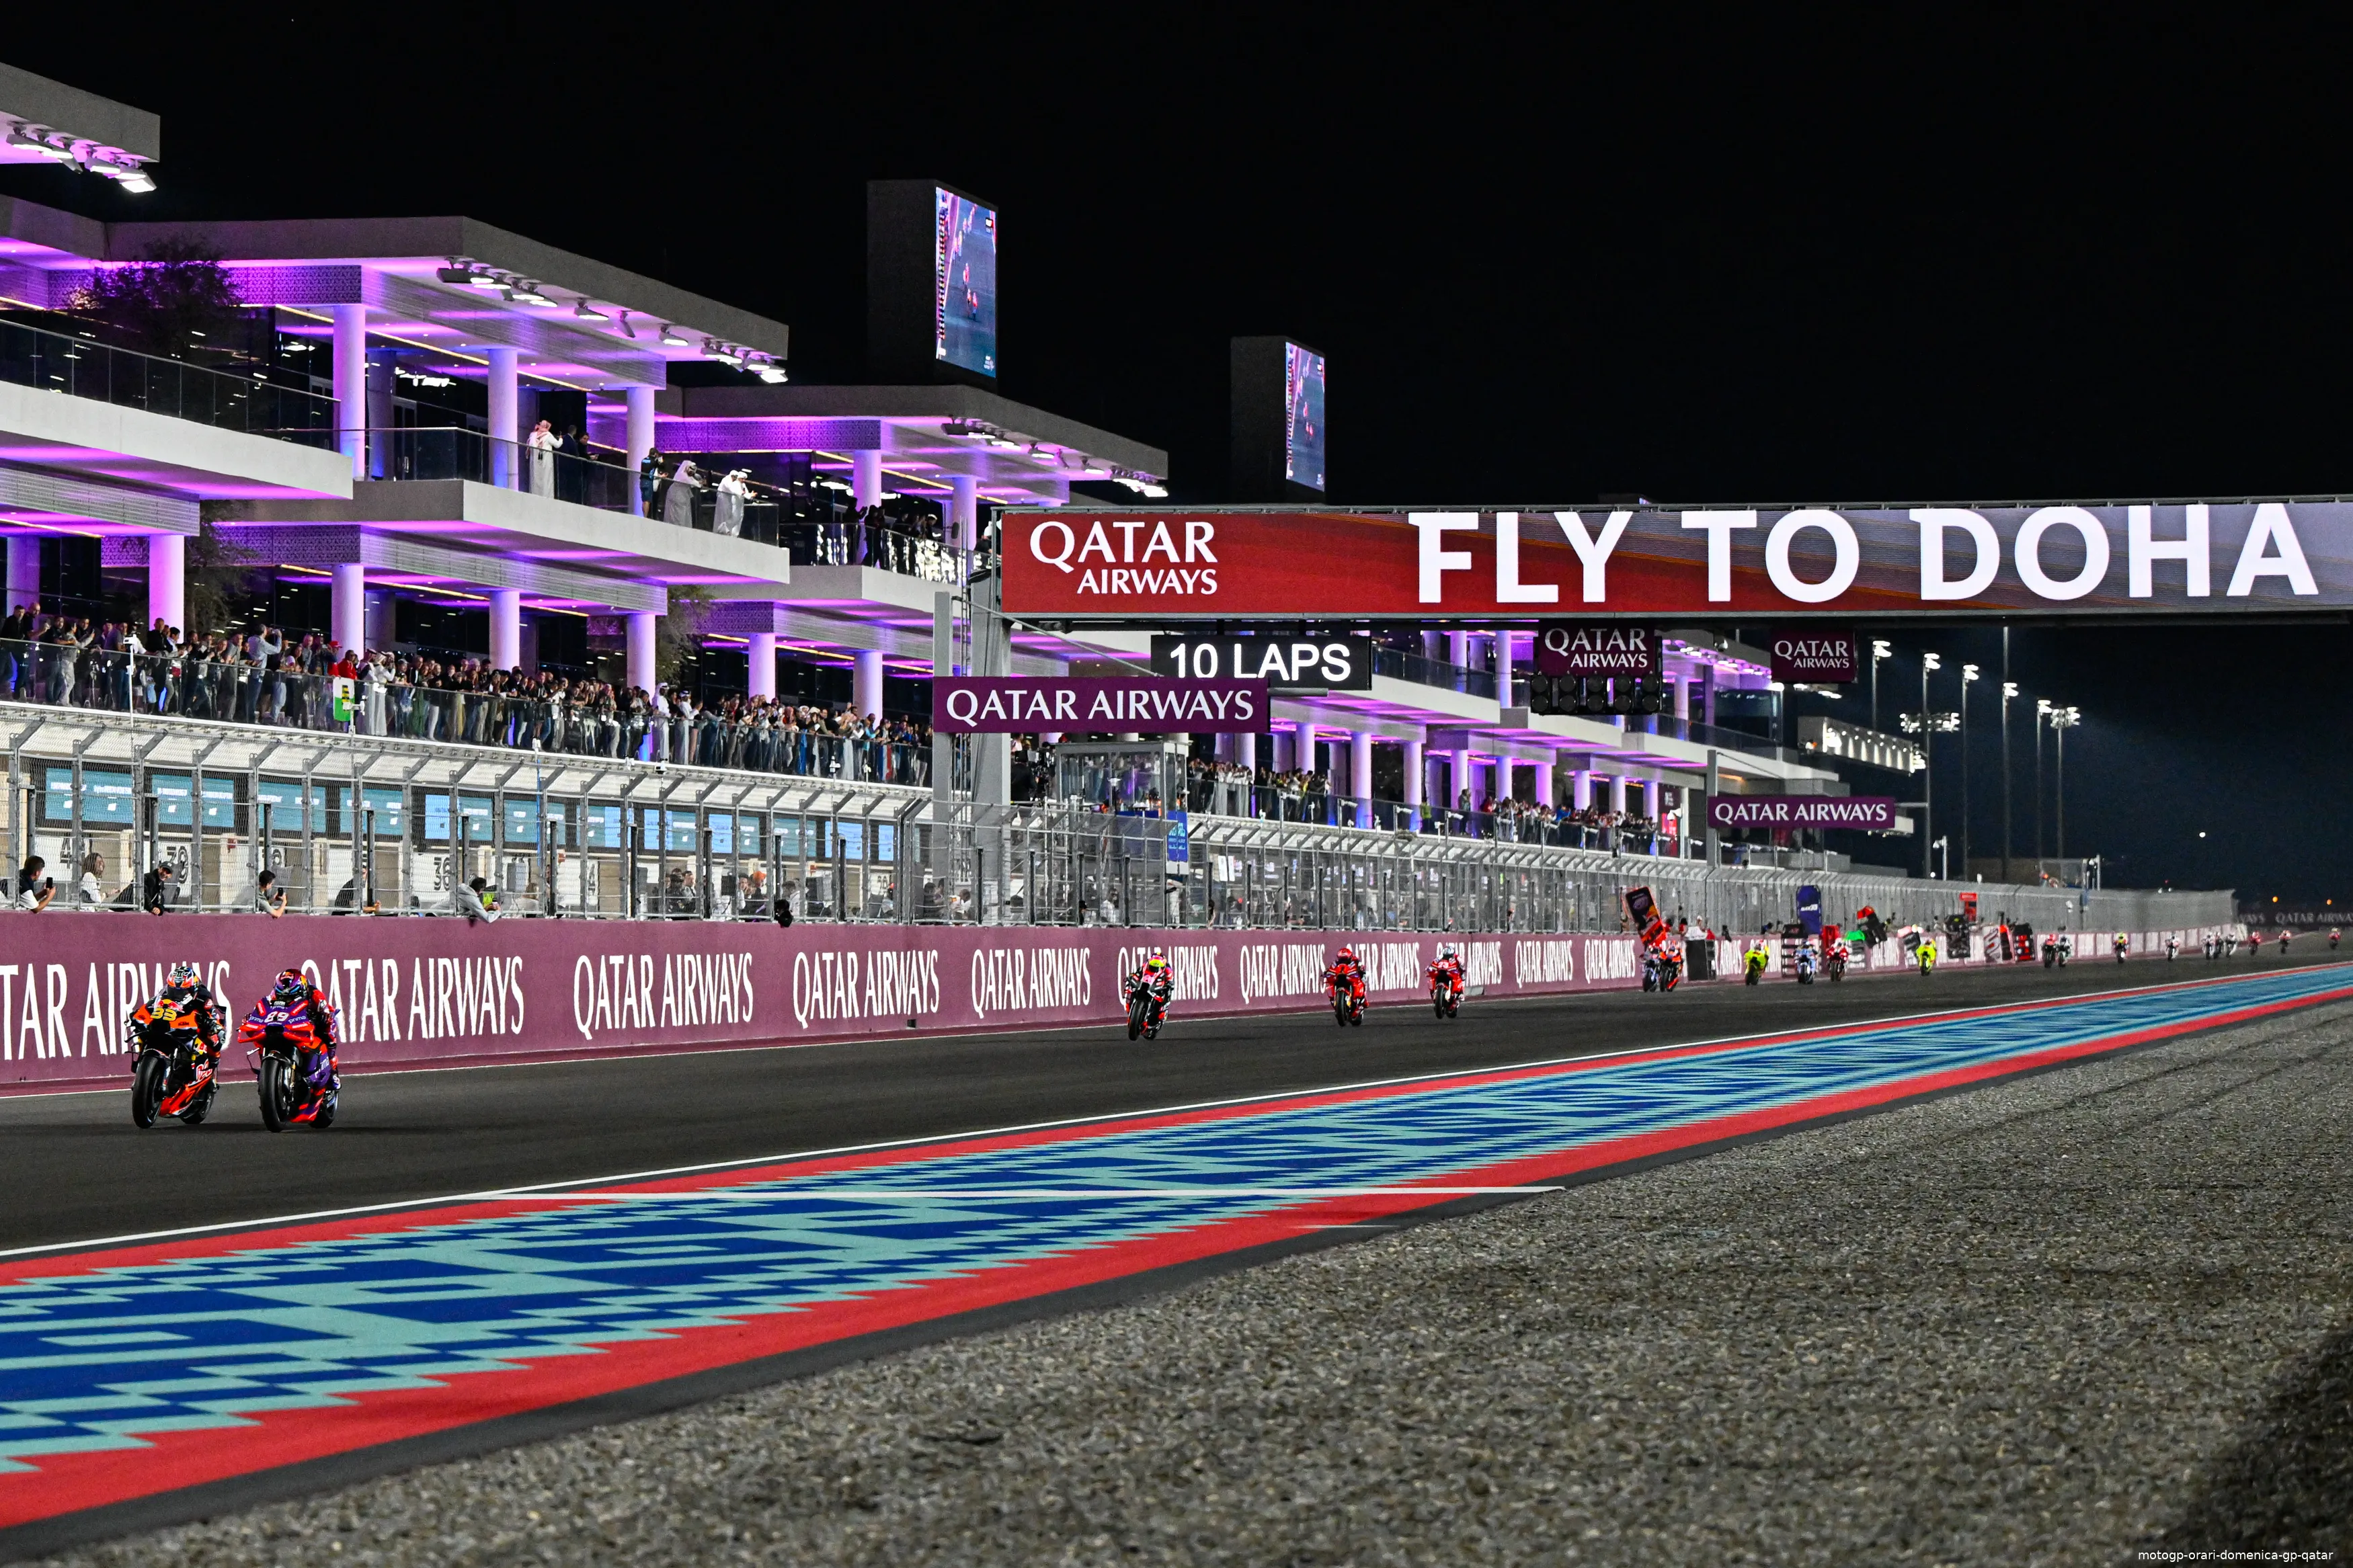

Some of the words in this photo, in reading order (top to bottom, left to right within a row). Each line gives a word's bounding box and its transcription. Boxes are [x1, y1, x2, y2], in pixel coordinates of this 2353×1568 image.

[1030, 521, 1218, 573] QATAR
[1408, 511, 1634, 603] FLY
[1681, 509, 1860, 603] TO
[1909, 503, 2319, 600] DOHA
[1077, 569, 1218, 595] AIRWAYS
[1170, 643, 1218, 678] 10
[1234, 643, 1351, 682] LAPS
[1545, 628, 1647, 657] QATAR
[1570, 653, 1648, 667] AIRWAYS
[1774, 640, 1849, 661] QATAR
[1793, 658, 1849, 669] AIRWAYS
[947, 690, 1078, 727] QATAR
[1088, 690, 1253, 720] AIRWAYS
[1715, 803, 1789, 825] QATAR
[1794, 804, 1887, 821] AIRWAYS
[2275, 911, 2314, 925] QATAR
[2317, 912, 2353, 923] AIRWA
[971, 948, 1027, 1019] QATAR
[1029, 947, 1090, 1009] AIRWAYS
[1168, 945, 1218, 1001] AIRWAYS
[1240, 945, 1279, 1005] QATAR
[1280, 944, 1326, 996] AIRWAYS
[1347, 943, 1380, 991] TAR
[1380, 942, 1421, 991] AIRWAYS
[1466, 941, 1502, 987] AIRWAYS
[1515, 940, 1542, 989] QATAR
[1542, 940, 1573, 983] AIRWAYS
[1585, 939, 1608, 984] QATAR
[1609, 940, 1636, 979] AIRWAYS
[81, 960, 233, 1059] AIRS
[407, 956, 524, 1040] AIRWAYS
[573, 954, 655, 1040] QATAR
[660, 952, 754, 1028] AIRWAYS
[793, 951, 860, 1030] QATAR
[864, 950, 939, 1018] AIRWAYS
[151, 1007, 177, 1022] 33
[264, 1011, 289, 1023] 89
[288, 1016, 307, 1024] prima
